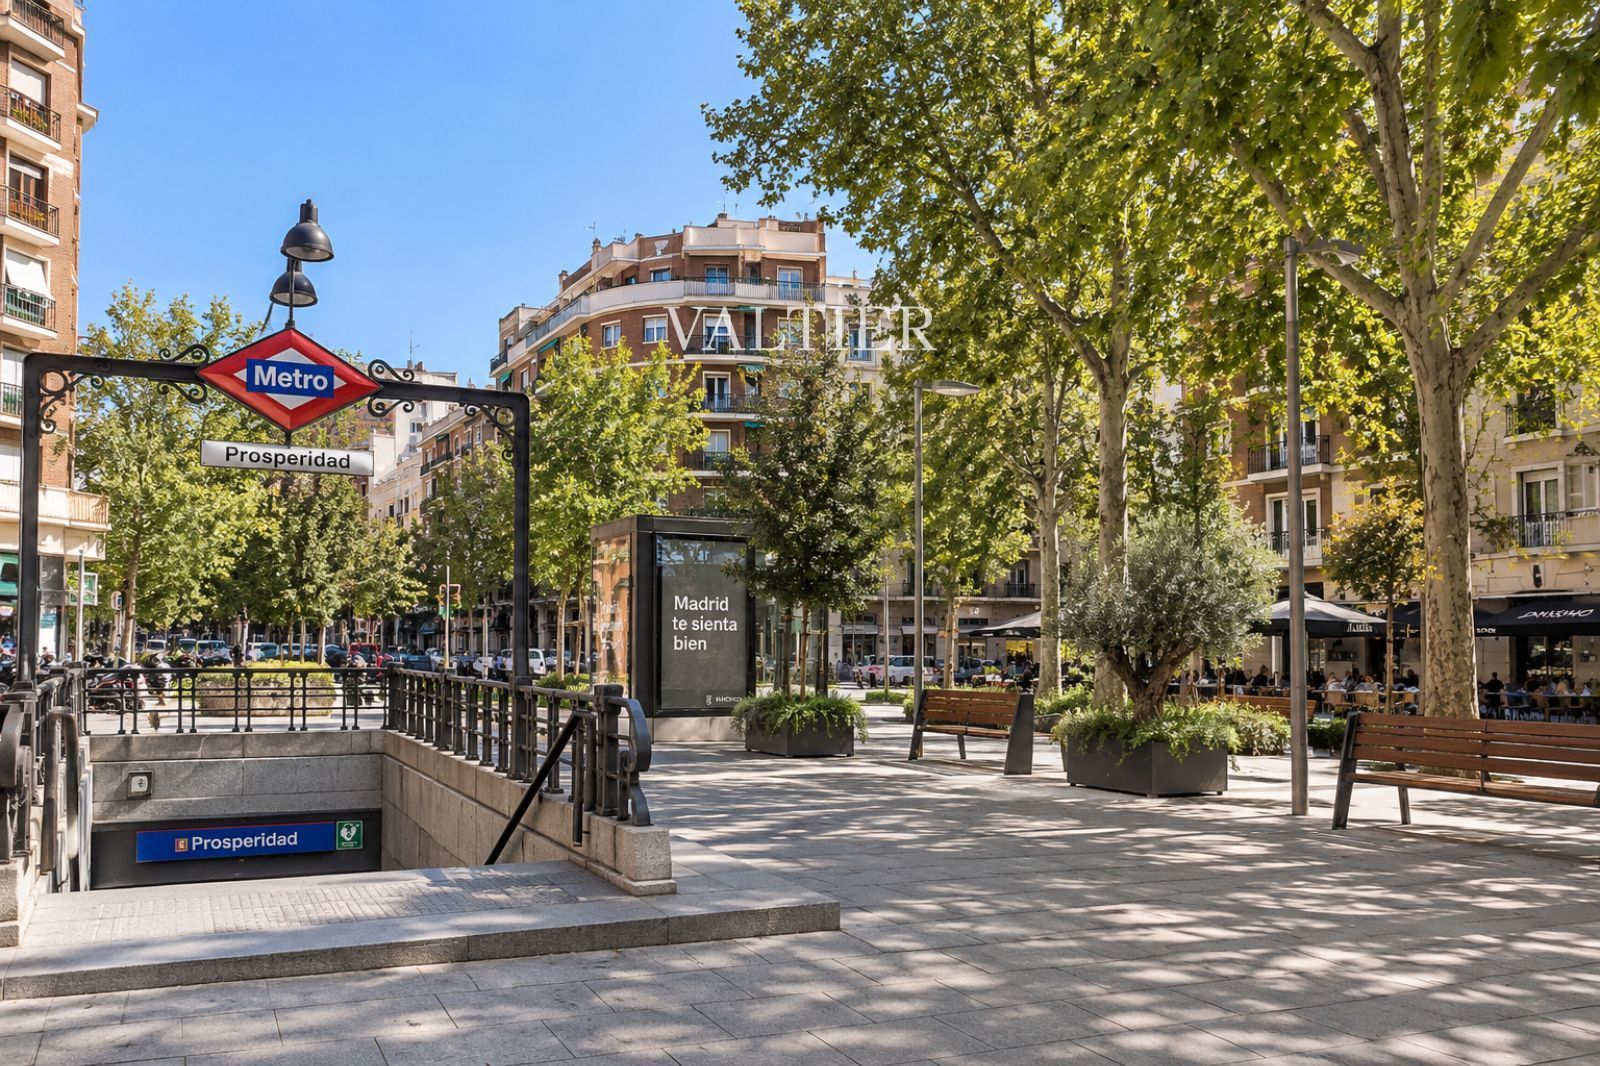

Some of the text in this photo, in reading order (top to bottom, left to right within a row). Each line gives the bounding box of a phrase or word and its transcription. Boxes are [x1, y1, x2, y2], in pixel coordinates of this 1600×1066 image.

[254, 365, 328, 390] Metro
[225, 446, 350, 469] Prosperidad
[674, 595, 729, 611] Madrid
[672, 615, 738, 631] te sienta
[673, 635, 707, 650] bien
[192, 832, 298, 851] Prosperidad
